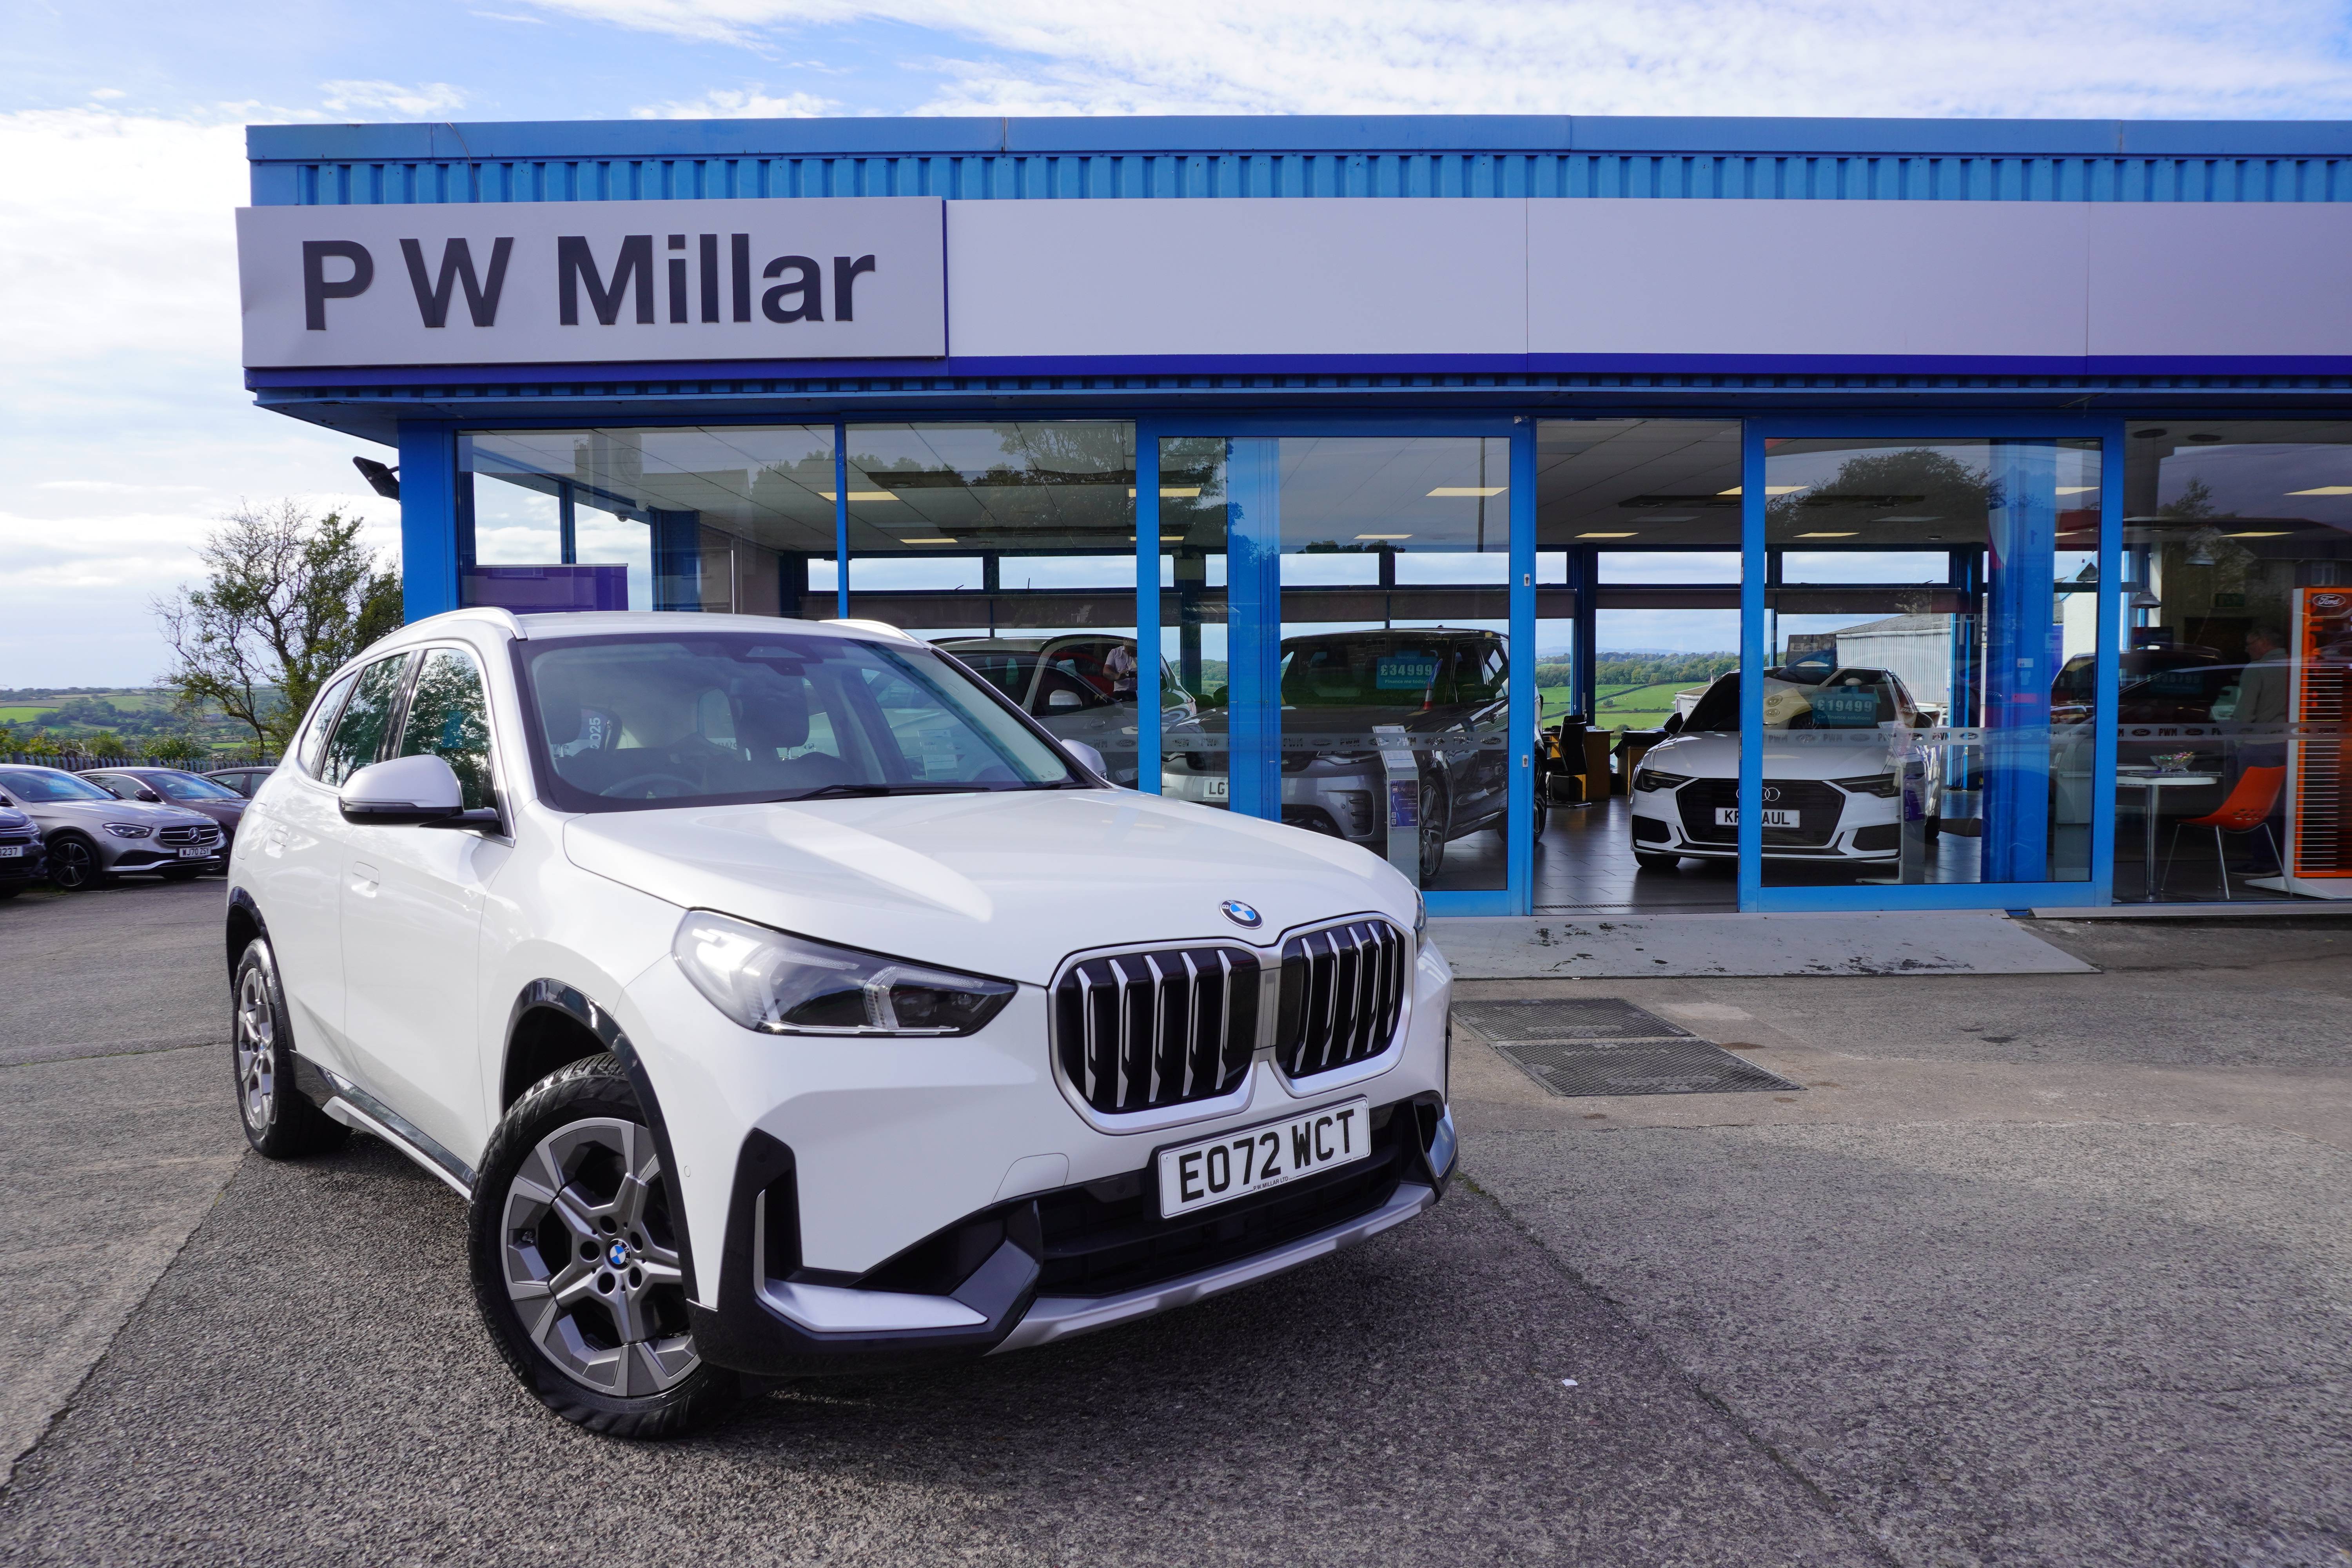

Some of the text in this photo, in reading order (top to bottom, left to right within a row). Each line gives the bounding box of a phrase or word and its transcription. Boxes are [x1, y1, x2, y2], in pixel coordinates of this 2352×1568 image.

[303, 233, 876, 331] P W Millar
[1380, 664, 1432, 676] £34999
[1817, 699, 1873, 712] £19499
[2158, 728, 2177, 736] PWM
[1397, 737, 1416, 746] PWM
[1209, 782, 1228, 795] LG
[1762, 811, 1790, 825] AUL
[1292, 1108, 1355, 1169] WCT
